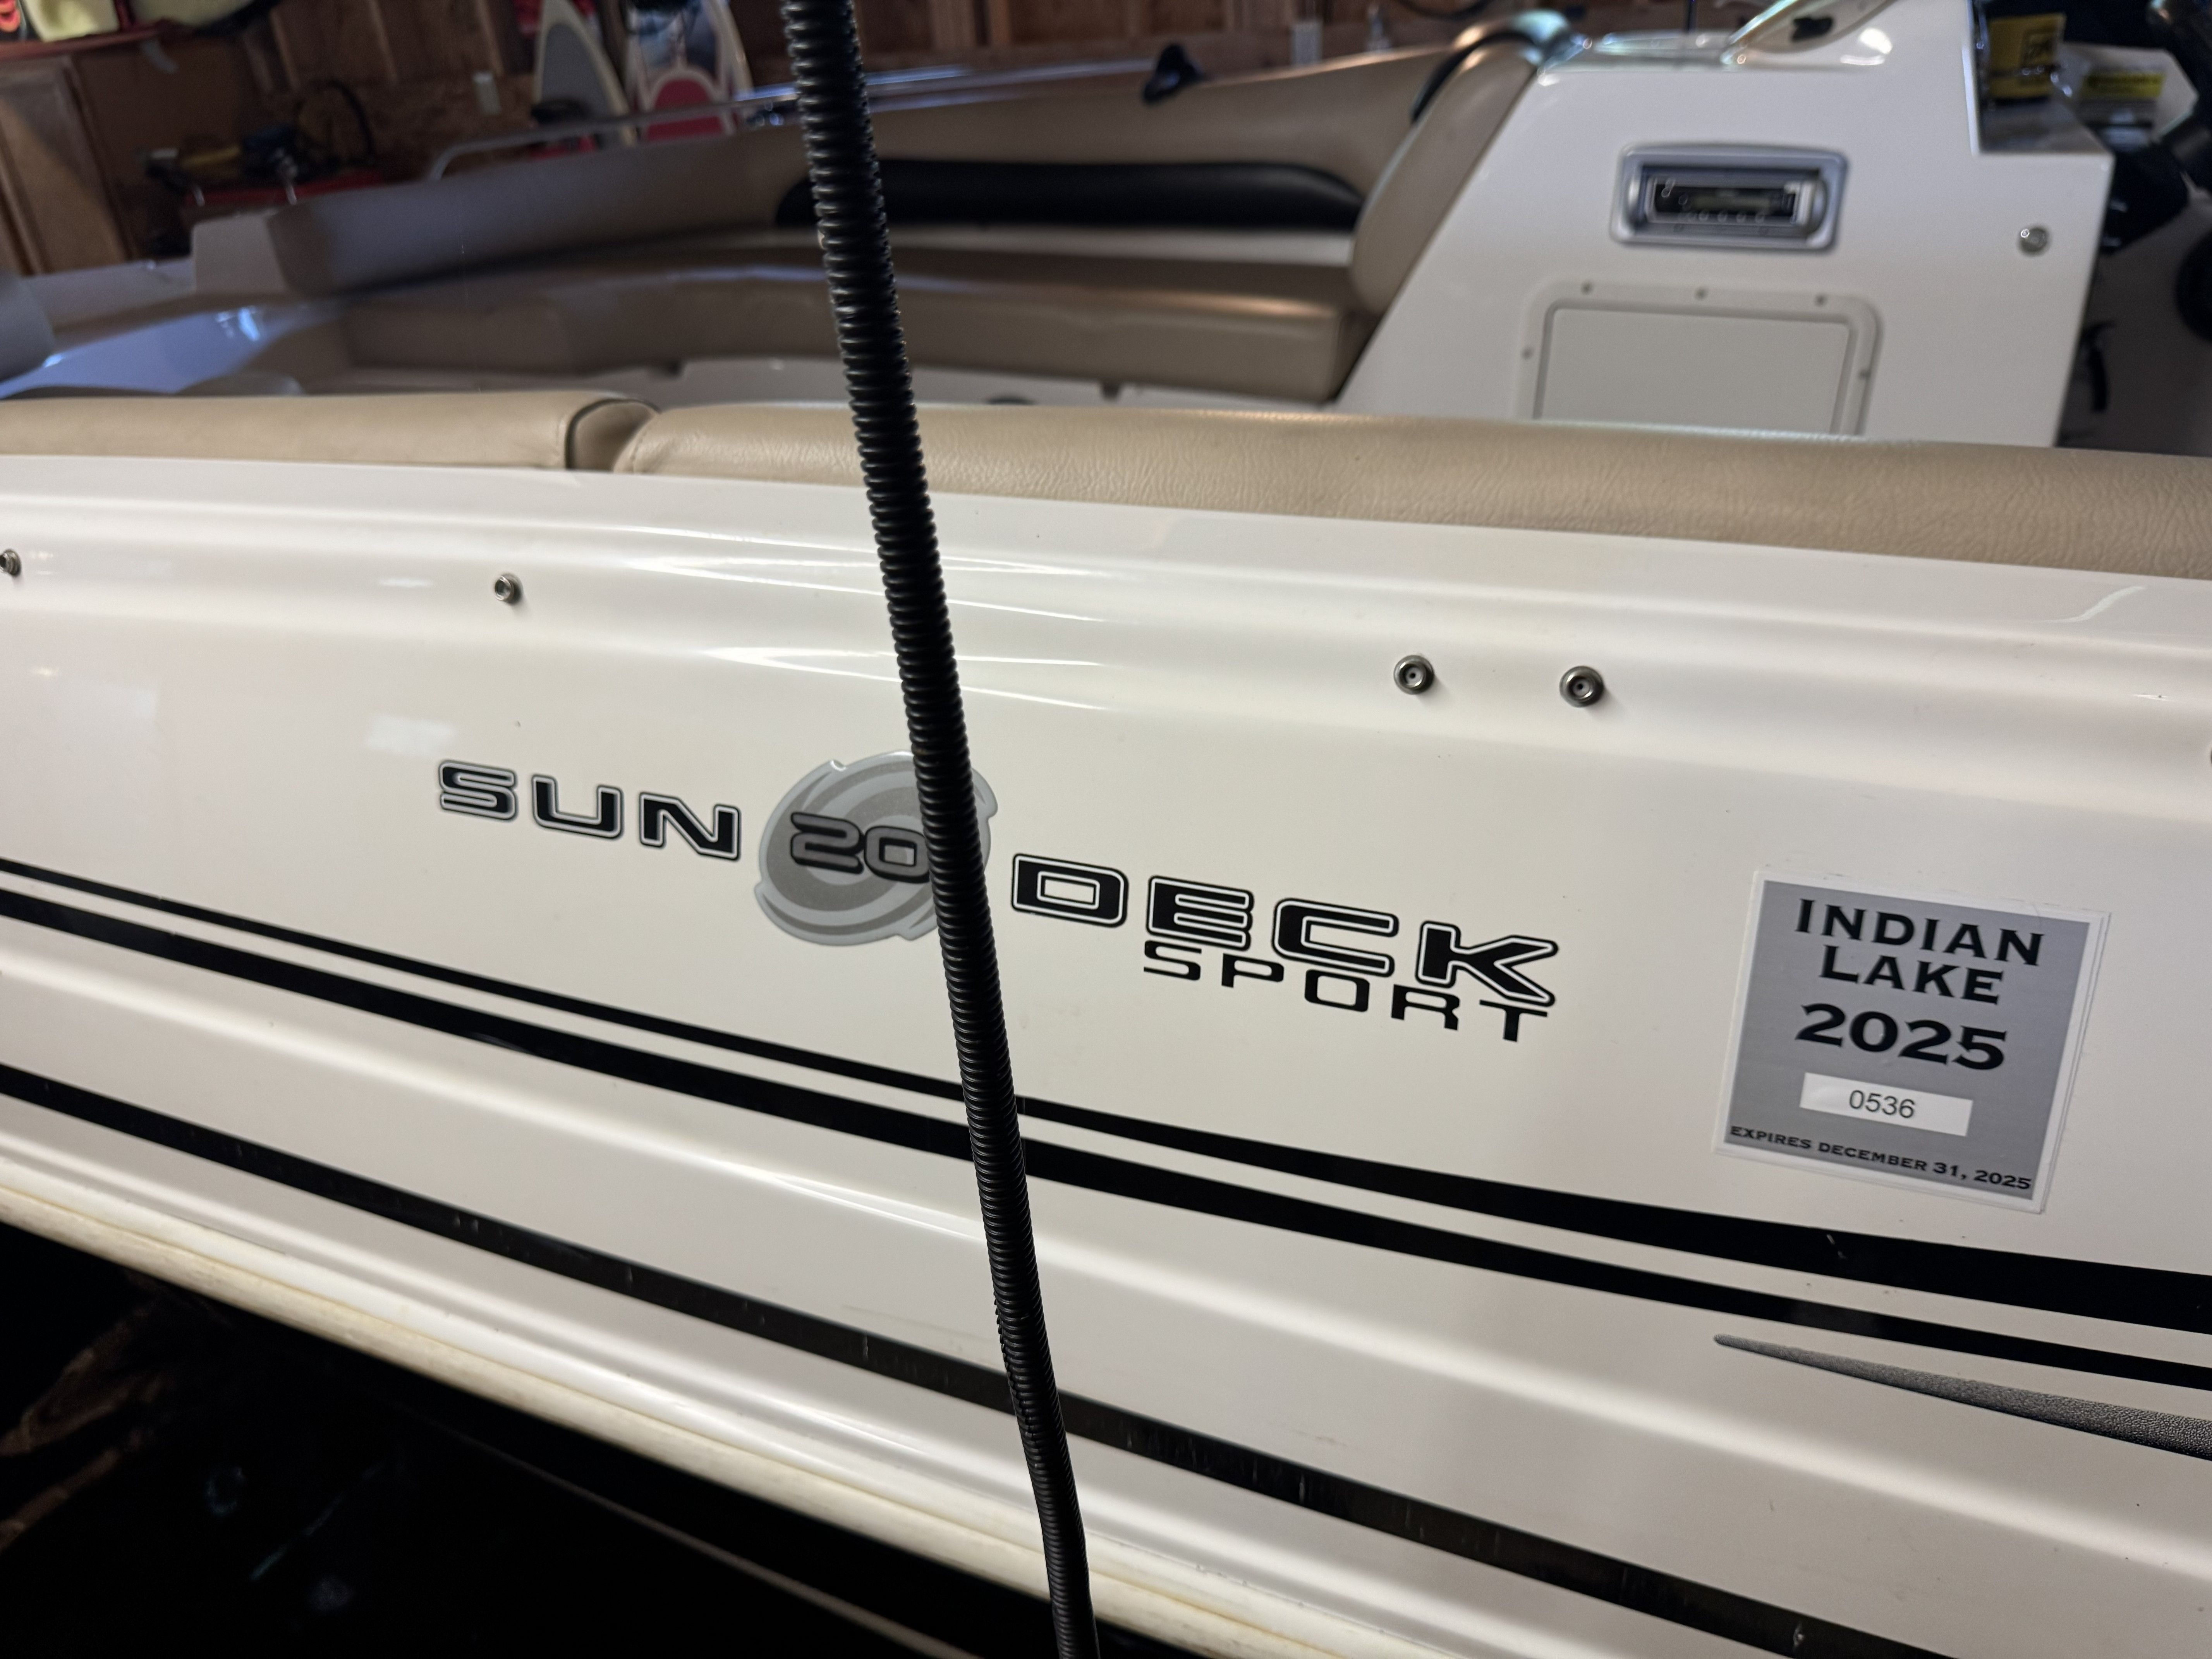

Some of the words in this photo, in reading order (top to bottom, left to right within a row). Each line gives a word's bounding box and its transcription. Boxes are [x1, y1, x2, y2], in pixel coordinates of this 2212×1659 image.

[438, 759, 741, 861] SUN
[790, 812, 930, 884] 20
[1012, 853, 1558, 1007] DECK
[1795, 898, 2044, 966] INDIAN
[1144, 940, 1548, 1042] SPORT
[1819, 945, 2004, 1005] LAKE
[1795, 1003, 2007, 1070] 2025
[1849, 1089, 1915, 1119] 0536
[1729, 1125, 1811, 1149] EXPIRES
[1818, 1141, 1928, 1171] DECEMBER
[1933, 1162, 1967, 1180] 31,
[1973, 1170, 2032, 1190] 2025
